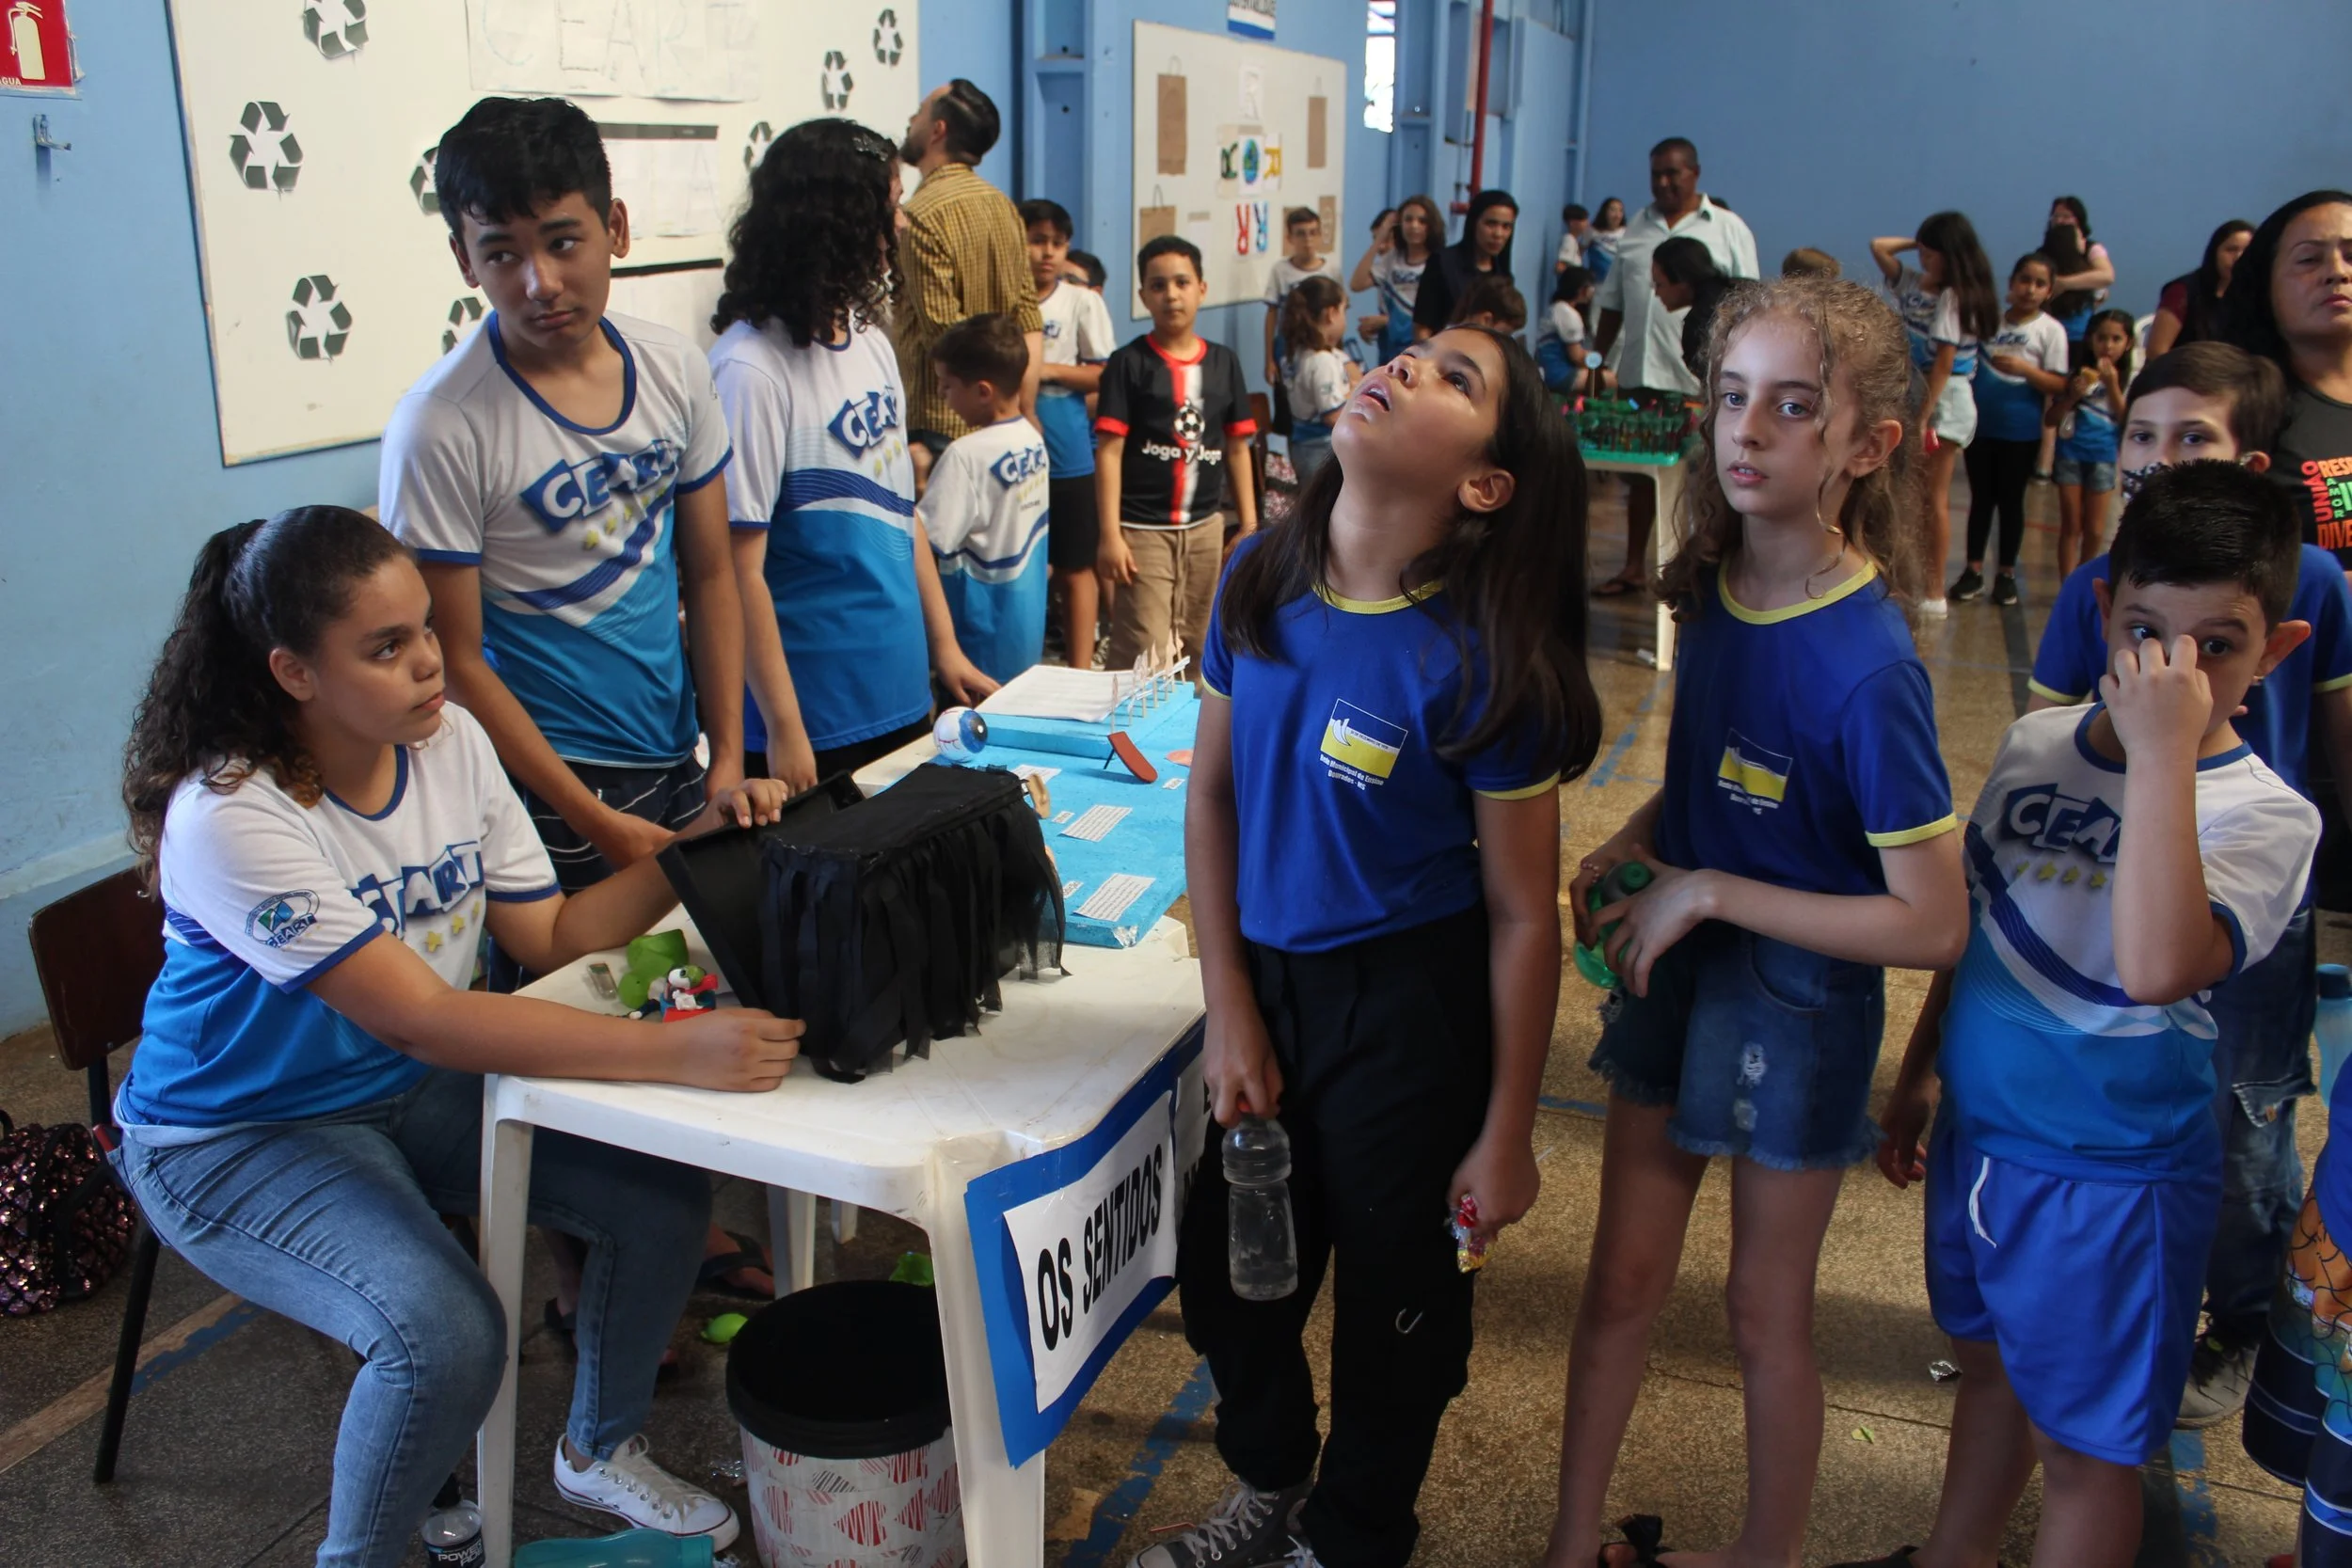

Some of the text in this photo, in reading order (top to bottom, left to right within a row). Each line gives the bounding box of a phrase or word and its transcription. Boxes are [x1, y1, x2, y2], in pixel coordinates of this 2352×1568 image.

[0, 76, 22, 86] GUA
[1184, 449, 1195, 464] y
[2318, 457, 2352, 478] RES
[1038, 1144, 1162, 1352] OS SENTIDOS
